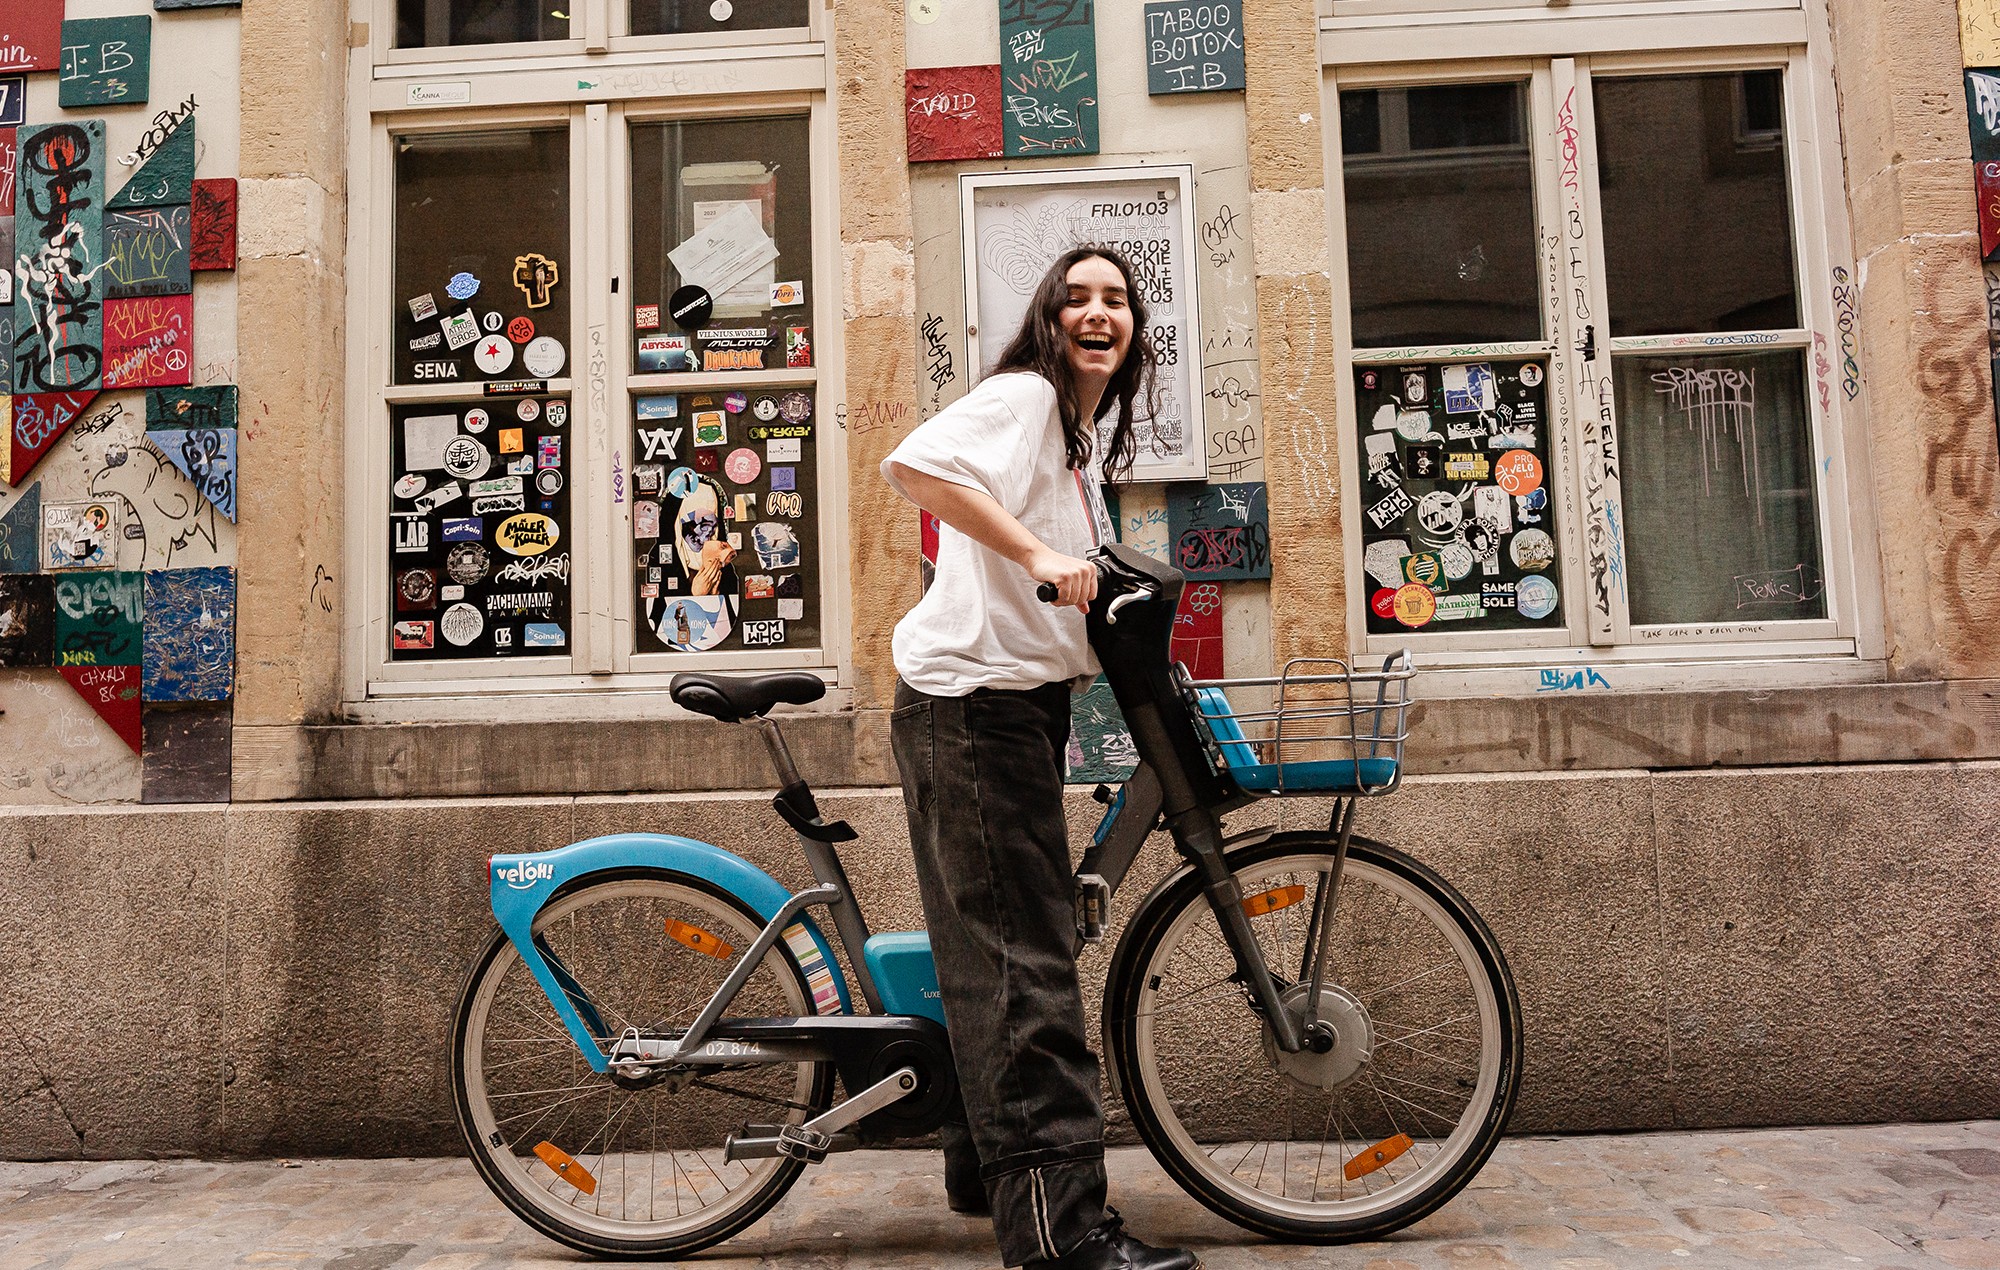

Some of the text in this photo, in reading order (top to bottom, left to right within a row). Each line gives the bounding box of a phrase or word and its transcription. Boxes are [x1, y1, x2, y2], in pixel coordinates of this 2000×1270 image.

[1146, 4, 1230, 38] TABOO
[1151, 27, 1242, 65] BOTOX
[1091, 201, 1169, 217] FRI.01.03
[1066, 214, 1166, 230] TRAVEL ON
[1086, 226, 1170, 242] THE BEAT
[1120, 250, 1171, 267] ACKIE
[451, 328, 477, 346] GROS
[707, 339, 773, 347] MOLOTOV
[641, 341, 684, 350] ABYSSAL
[788, 355, 809, 364] FREE
[413, 363, 458, 378] SENA
[1514, 455, 1533, 464] PRO
[1446, 470, 1489, 478] NO CRIME
[1369, 490, 1402, 515] TOM
[1377, 498, 1411, 527] WHO
[1482, 582, 1514, 593] SAME
[487, 592, 553, 610] PACHAMAMA
[1482, 597, 1514, 608] SOLE
[488, 608, 551, 617] FAMILY
[745, 621, 780, 632] TOM
[1175, 614, 1194, 626] ER
[747, 631, 783, 645] WHO
[1640, 629, 1662, 639] TAKE
[1709, 627, 1732, 635] EACH
[706, 1041, 761, 1056] 02 874
